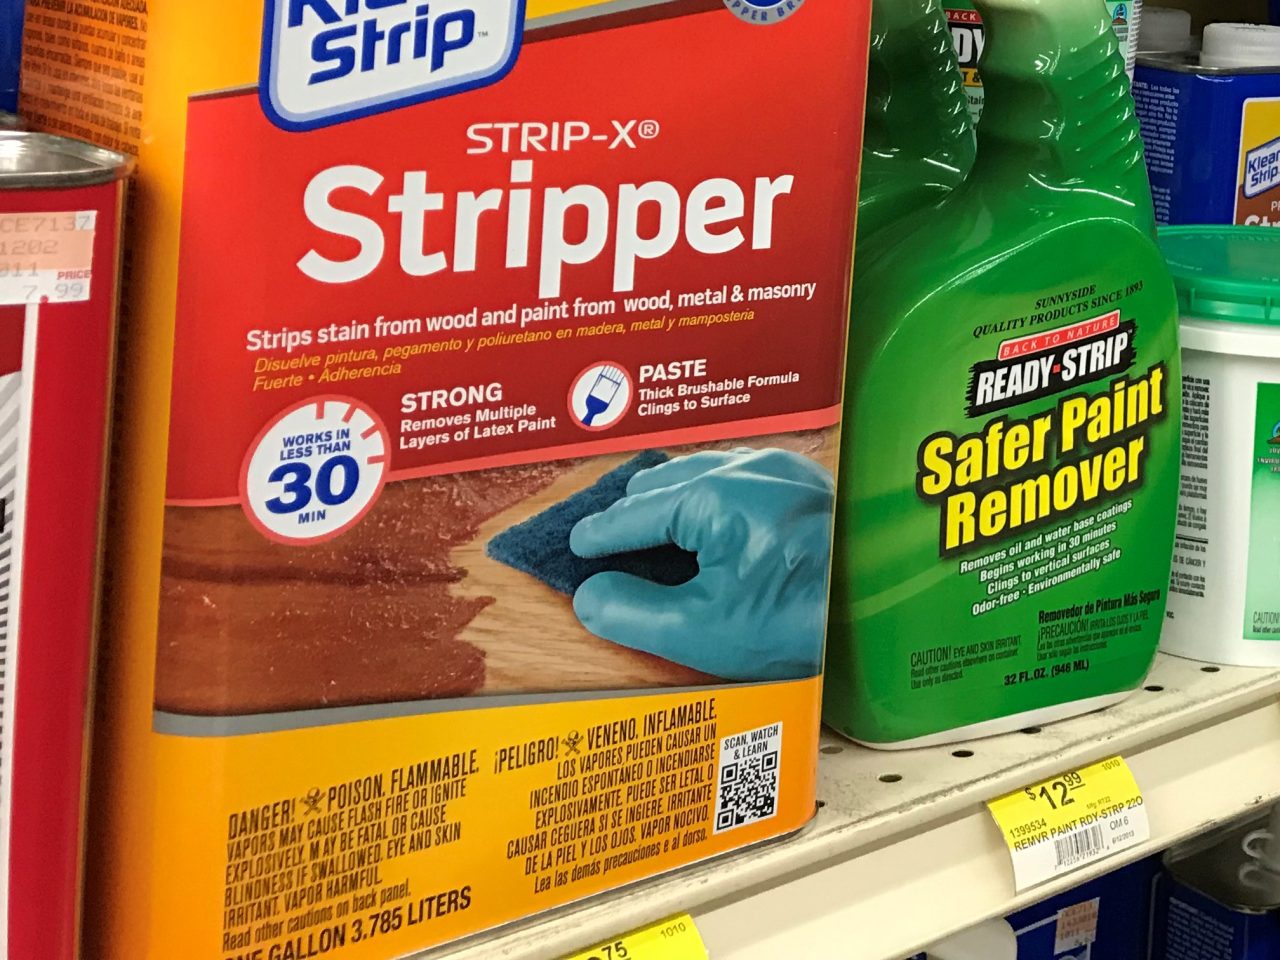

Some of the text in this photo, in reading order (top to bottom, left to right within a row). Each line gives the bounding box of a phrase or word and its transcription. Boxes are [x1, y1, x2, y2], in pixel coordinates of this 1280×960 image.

[308, 5, 475, 86] Strip
[1251, 166, 1279, 187] Strip
[296, 159, 795, 300] Stripper
[973, 280, 1143, 338] QUALITY PRODUCTS SINCE 1893
[1035, 284, 1096, 310] SUNNYSIDE
[246, 283, 816, 352] Strips stain from wood and paint from wood, metal & masonry
[1003, 315, 1115, 356] BACK TO NATURE
[639, 359, 706, 383] PASTE
[639, 371, 800, 401] Thick Brushable Formula
[401, 383, 502, 412] STRONG
[637, 393, 751, 417] Clings to Surface
[400, 416, 557, 449] Layers of Latex Paint
[401, 403, 537, 432] Removes Multiple
[923, 368, 1163, 495] Safer Paint
[280, 441, 351, 461] LESS THAN
[283, 428, 350, 448] WORKS IN
[265, 455, 359, 515] 30
[945, 436, 1144, 550] Remover
[298, 510, 326, 524] MIN
[960, 500, 1132, 574] Removes oil and water base coatings
[724, 725, 778, 750] SCAN, WATCH
[734, 742, 768, 760] & LEARN
[229, 750, 479, 840] DANGER! POISON. FLAMMABLE.
[1009, 818, 1047, 839] 1399534
[1014, 834, 1049, 852] REMVR
[1051, 820, 1077, 837] PAINT
[1080, 802, 1124, 826] RDY-STRP
[351, 886, 471, 943] 3.785 LITERS
